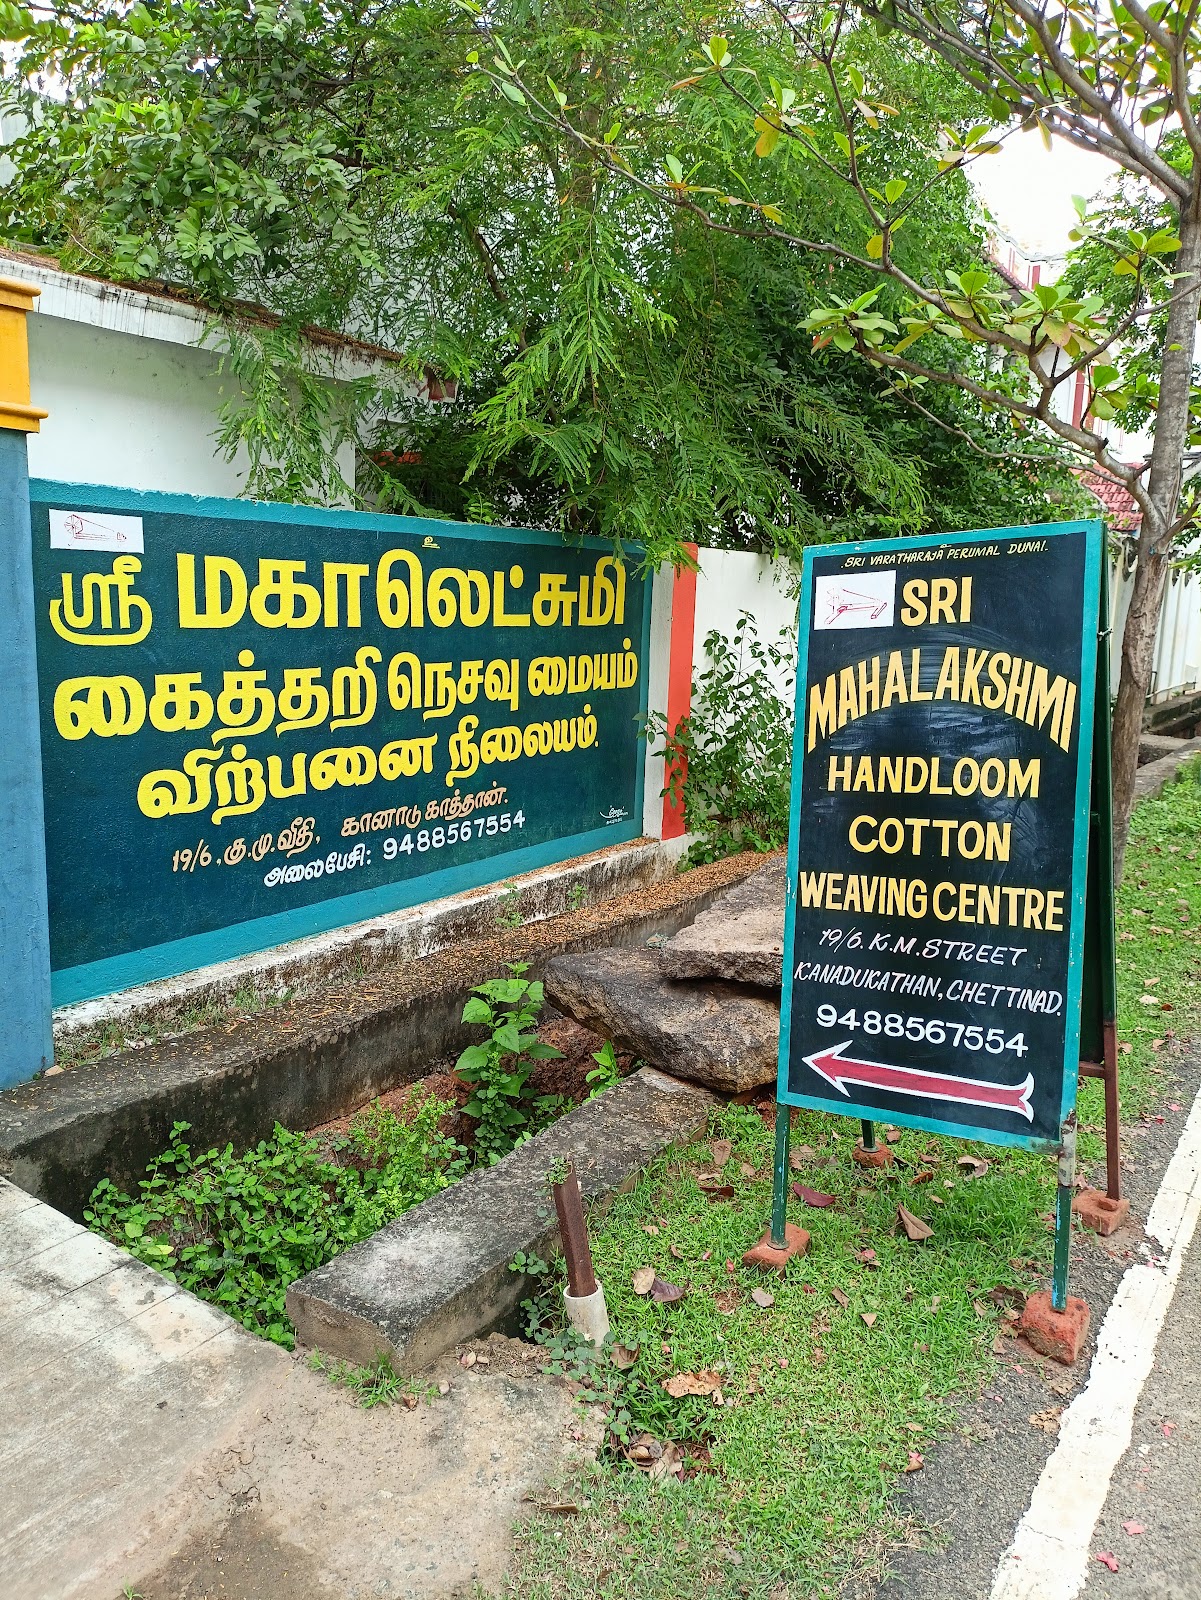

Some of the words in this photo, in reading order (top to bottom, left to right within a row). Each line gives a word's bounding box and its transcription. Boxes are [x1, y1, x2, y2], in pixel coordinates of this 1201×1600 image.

[870, 550, 944, 566] VARATHARAJA
[947, 545, 1000, 559] PERUMAL
[49, 554, 152, 646] ஸ்ரீ
[176, 548, 626, 629] மகாலெட்சுமி
[900, 576, 973, 627] SRI
[54, 646, 382, 746] கைத்தறி
[387, 652, 520, 722] நெசவு
[527, 637, 638, 697] மையம்
[808, 646, 1077, 754] MAHALAKSHMI
[137, 732, 438, 825] விற்பனை
[444, 704, 599, 788] நிலையம்.
[827, 755, 1041, 798] HANDLOOM
[340, 804, 421, 837] கானாடு
[383, 810, 526, 860] 9488567554
[849, 815, 1012, 862] COTTON
[800, 871, 928, 919] WEAVING
[932, 882, 1065, 932] CENTRE
[816, 1004, 1028, 1058] 9488567554
